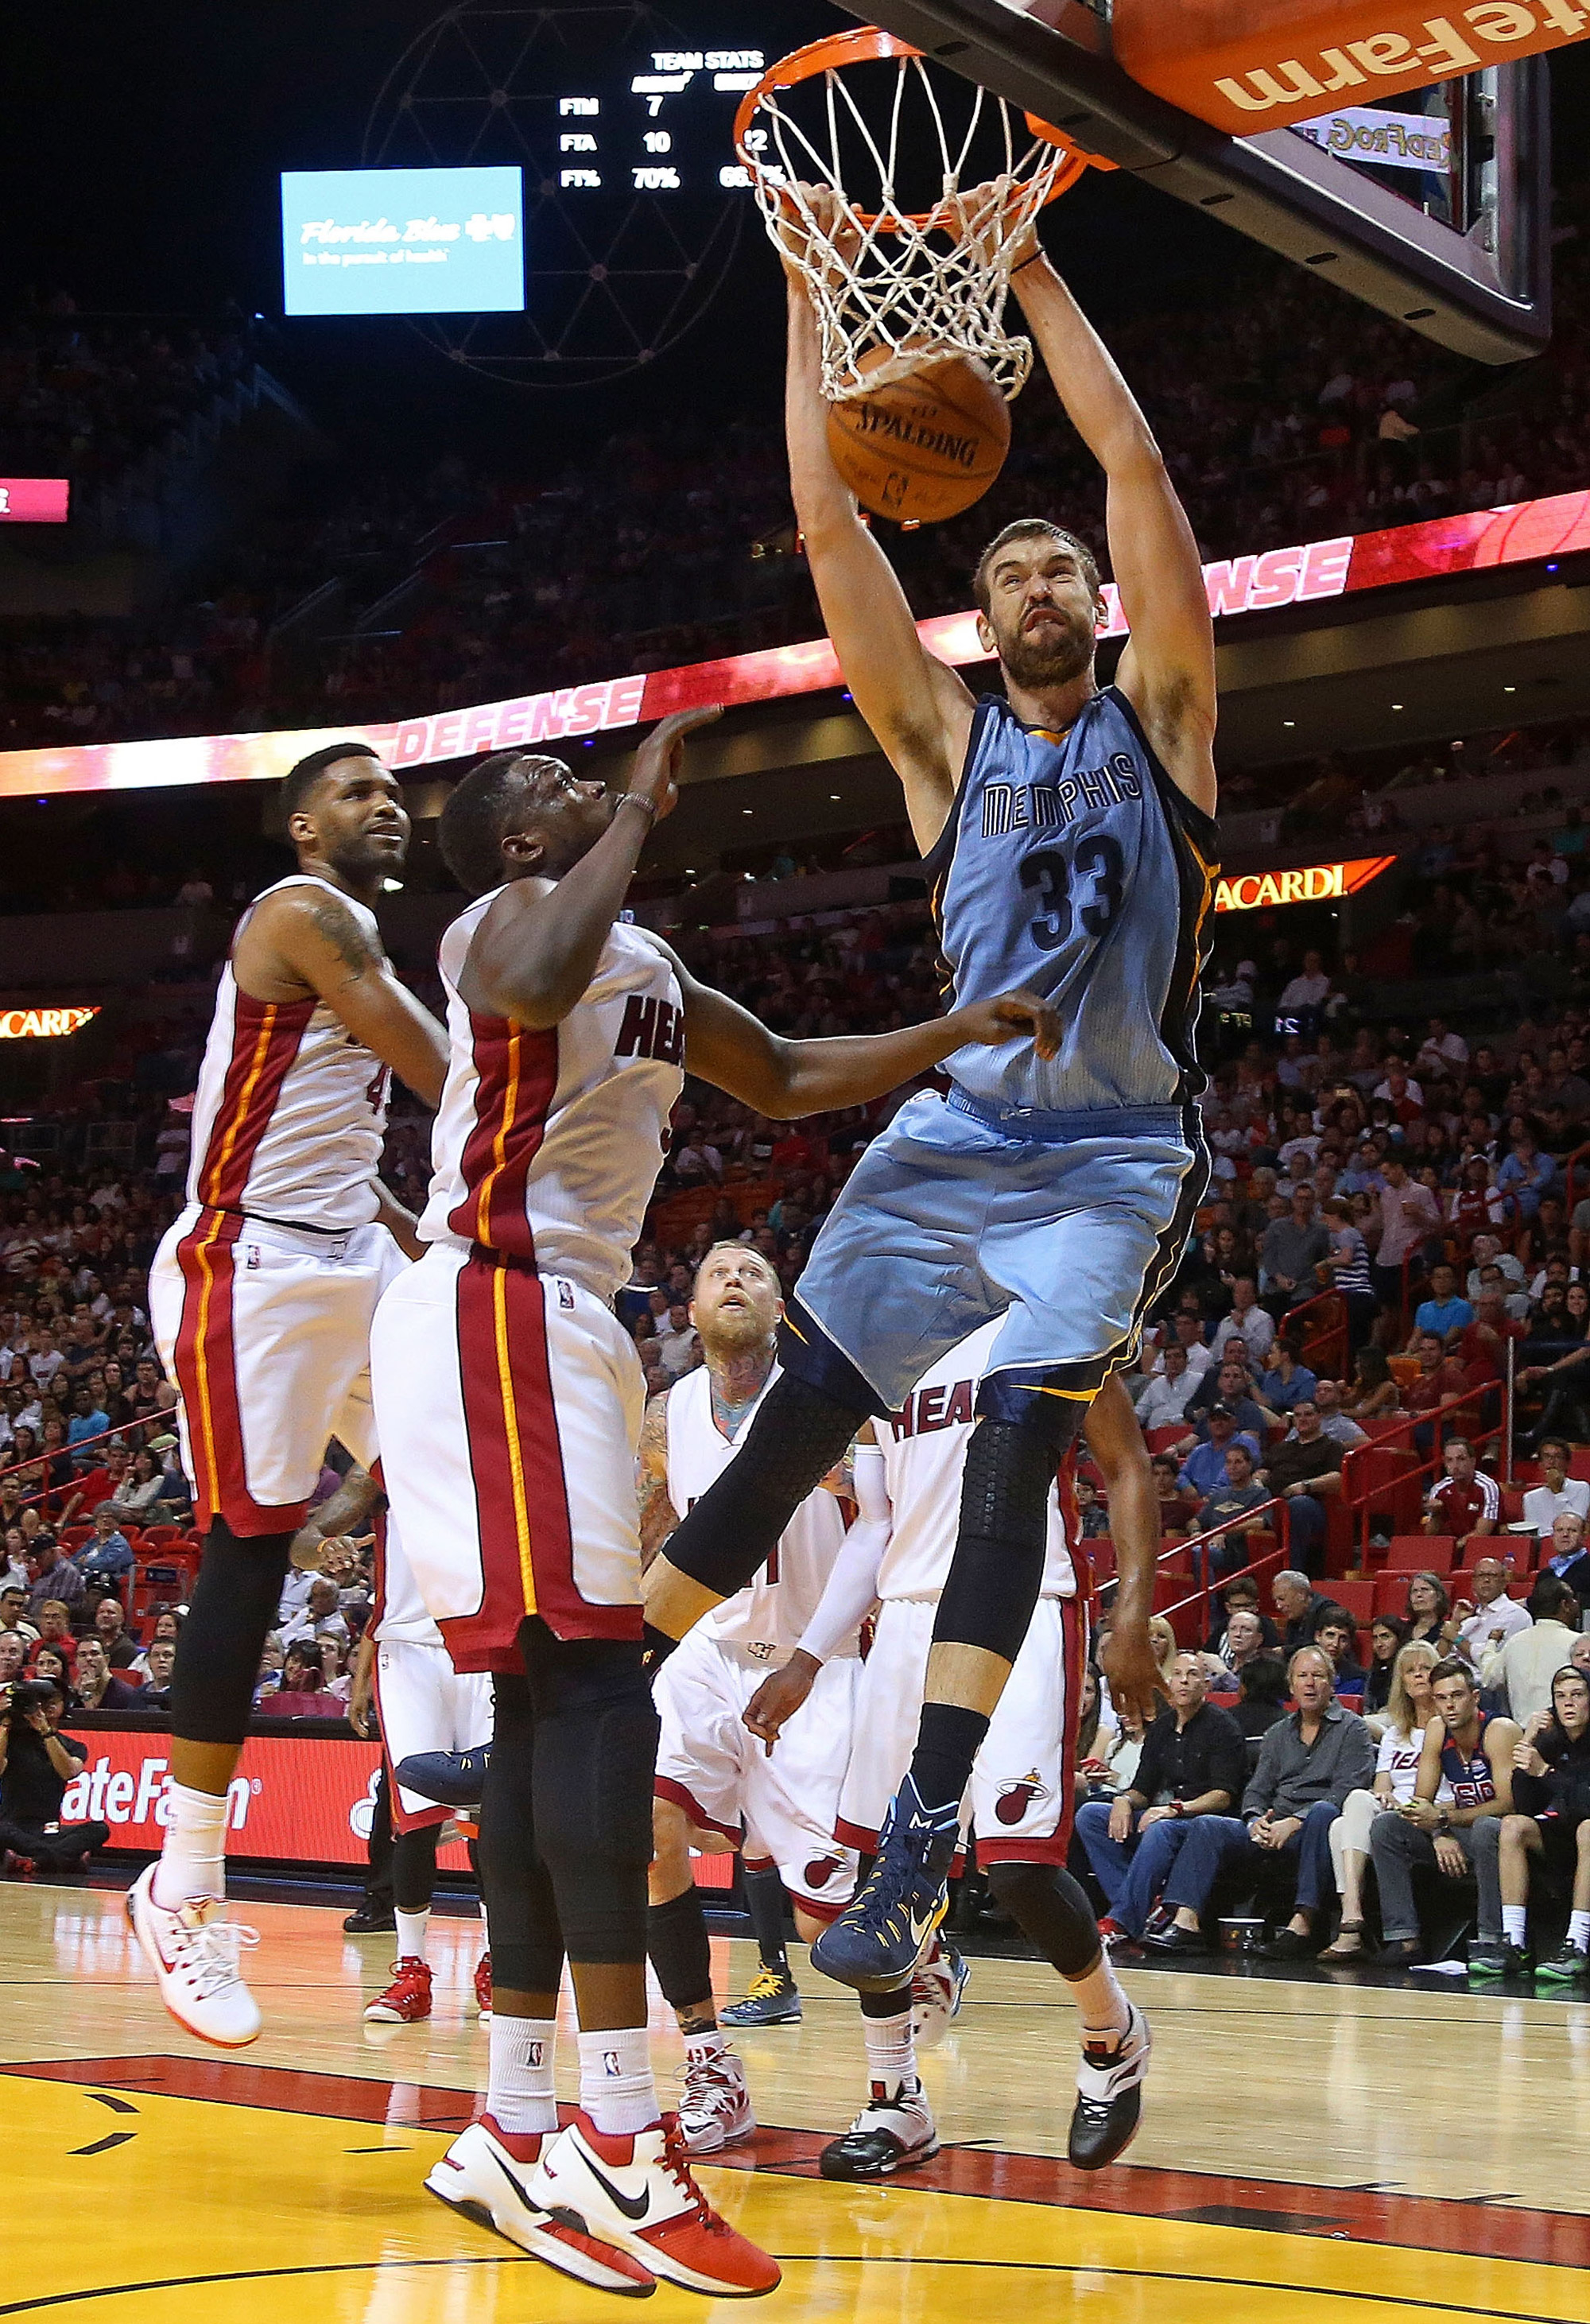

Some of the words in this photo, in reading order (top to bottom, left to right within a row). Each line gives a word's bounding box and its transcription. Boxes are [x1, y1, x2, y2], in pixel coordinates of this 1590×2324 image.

[650, 52, 704, 70] TEAM
[704, 51, 765, 70] STATS
[1213, 0, 1590, 111] teFarm
[645, 95, 665, 117] 7
[560, 133, 598, 152] FTA
[642, 130, 672, 153] 10
[630, 166, 681, 189] 70%
[855, 402, 980, 469] SPALDING
[390, 674, 646, 770] DEFENSE
[981, 751, 1143, 839] MEMPHIS
[1019, 834, 1124, 952] 33
[890, 1379, 974, 1444] HEA
